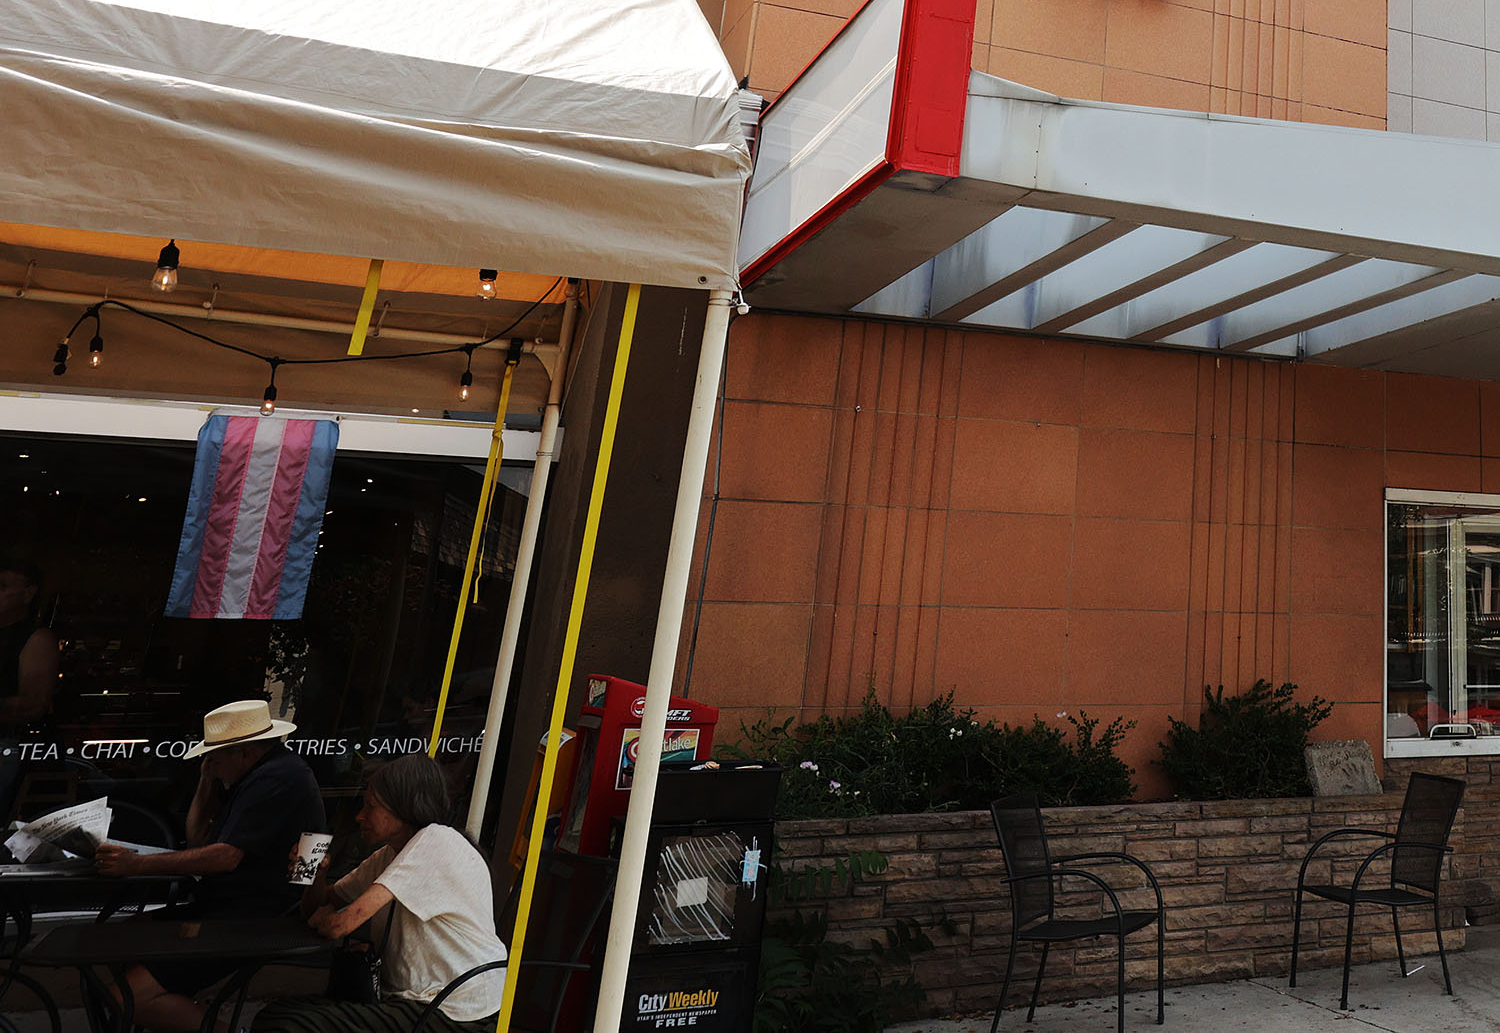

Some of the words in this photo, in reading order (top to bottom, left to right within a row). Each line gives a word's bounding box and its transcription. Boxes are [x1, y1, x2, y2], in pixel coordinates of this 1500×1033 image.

[19, 743, 59, 761] TEA
[81, 741, 137, 760] CHAI
[284, 738, 347, 756] STRIES
[366, 736, 484, 755] SANDWICHE
[638, 993, 668, 1012] City
[668, 989, 719, 1008] Weekly
[655, 1016, 698, 1029] FREE
